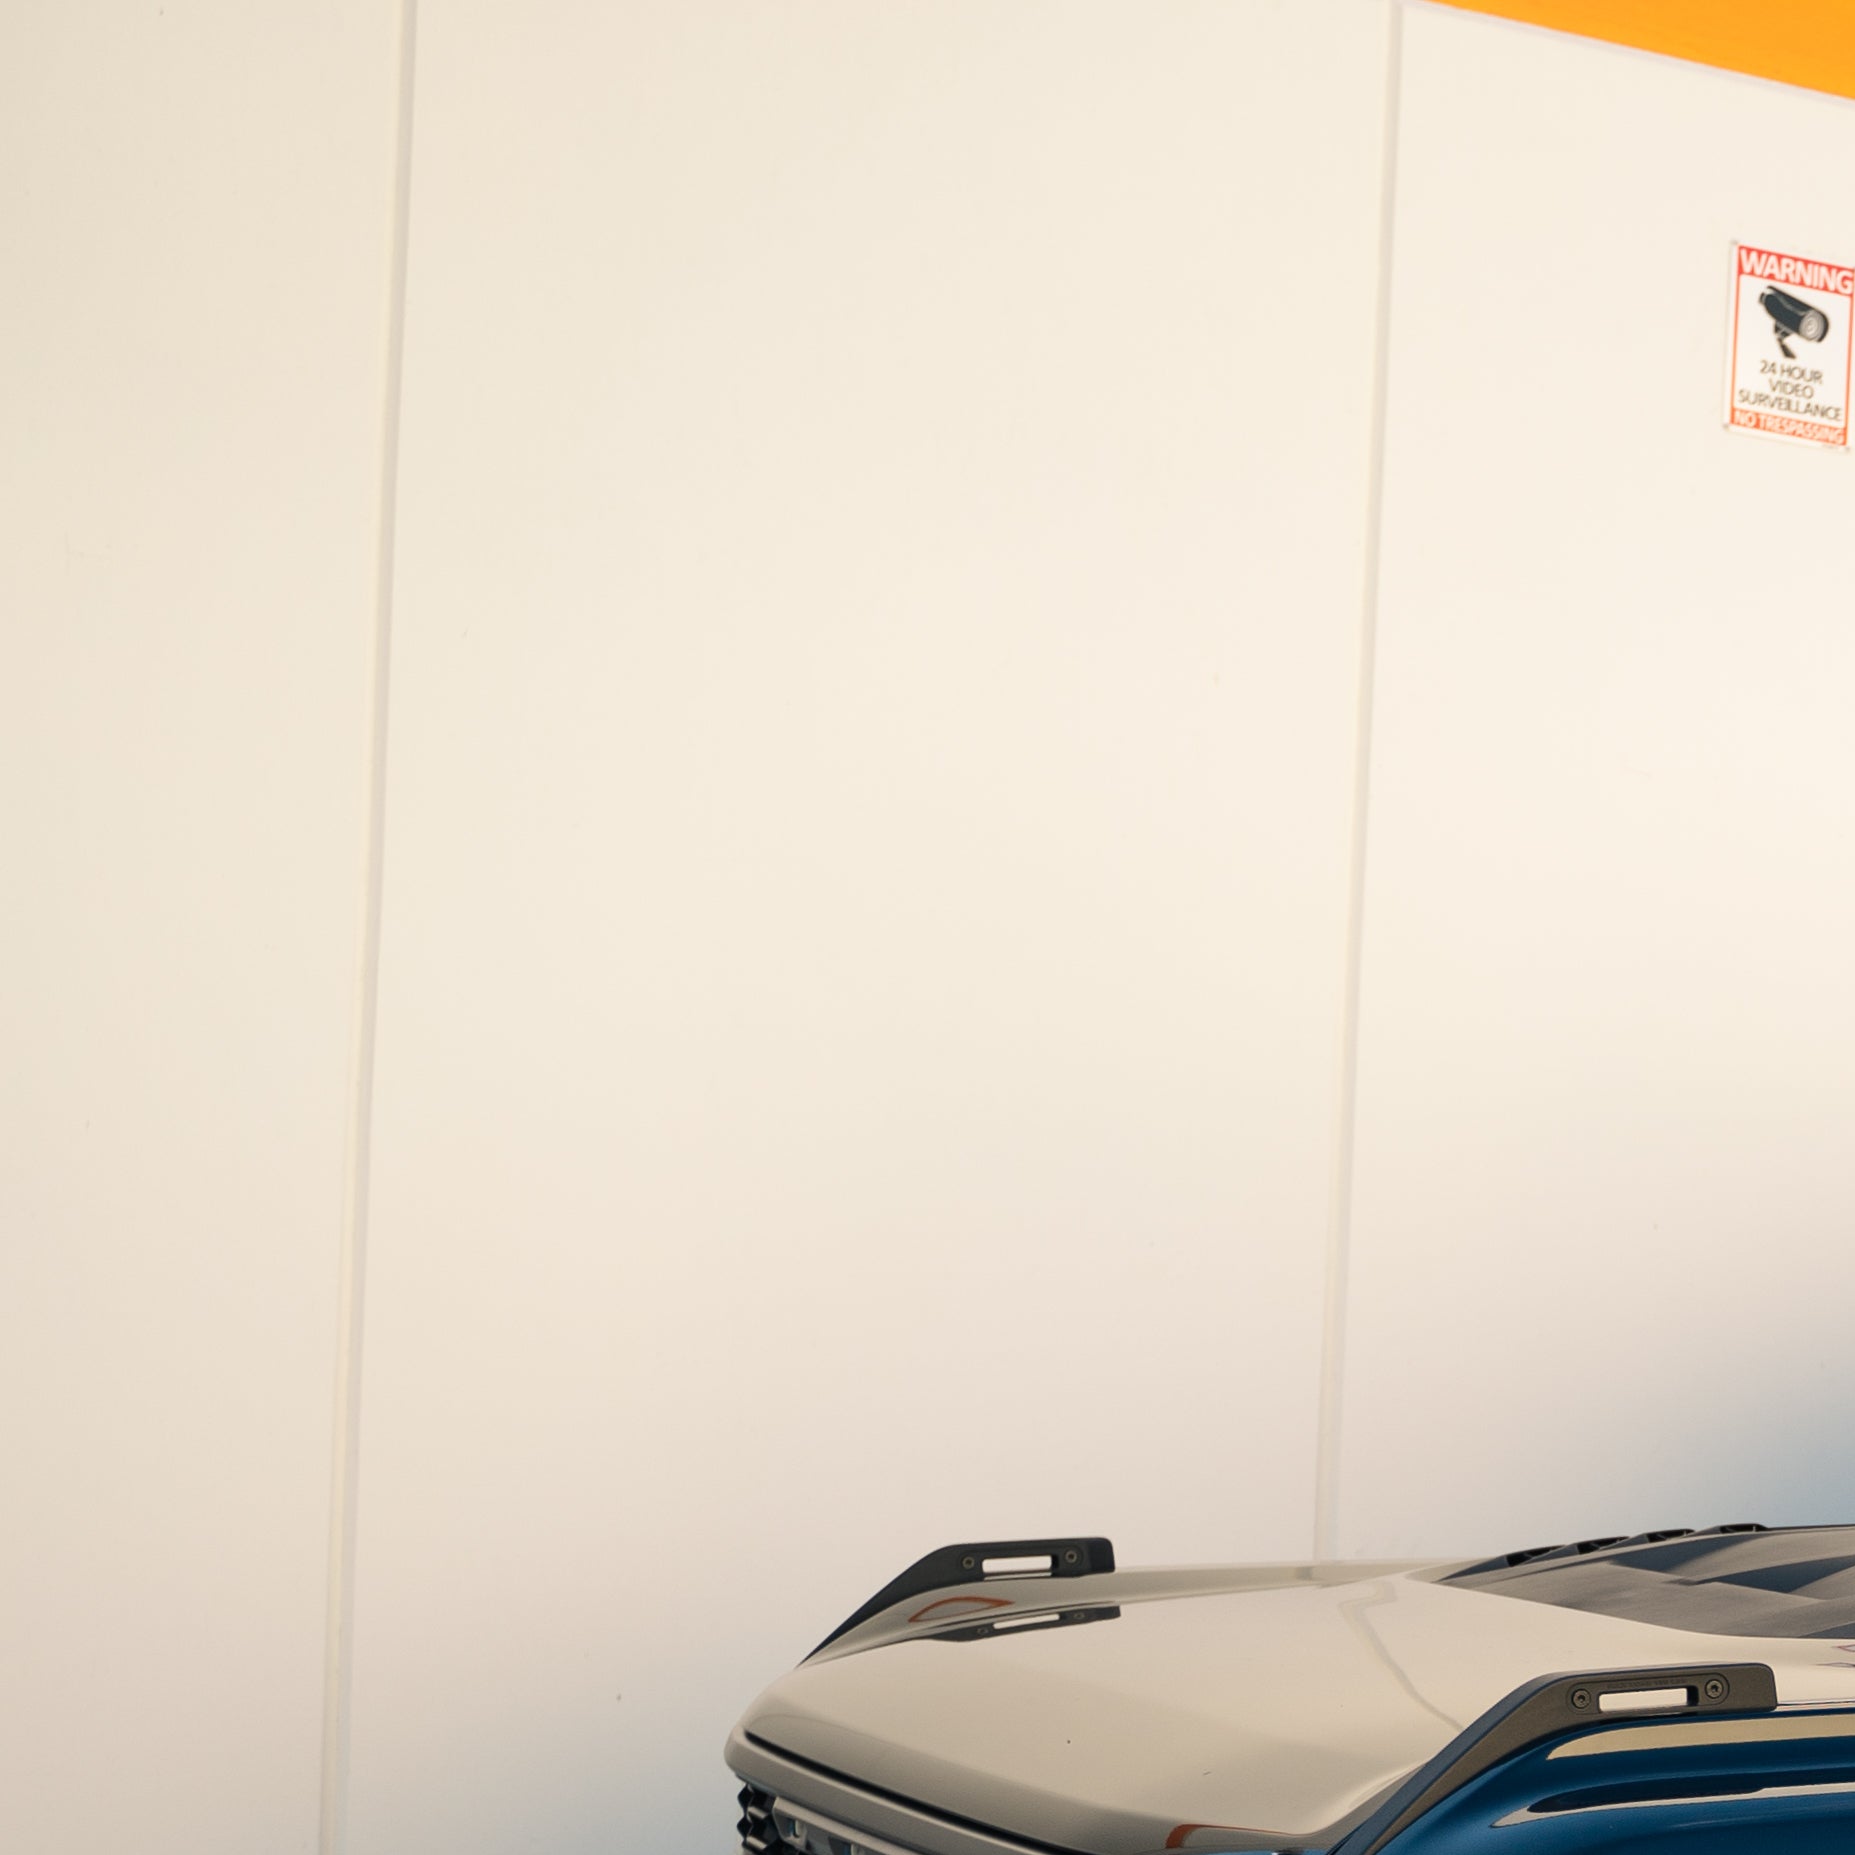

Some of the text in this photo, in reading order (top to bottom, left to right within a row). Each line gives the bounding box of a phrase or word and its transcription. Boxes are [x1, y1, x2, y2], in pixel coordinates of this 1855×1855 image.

[1739, 248, 1854, 295] WARNING
[1759, 359, 1823, 385] 24 HOUR
[1768, 378, 1814, 399] VIDEO
[1738, 388, 1842, 422] SURVEILLANCE
[1734, 410, 1845, 444] NO TRESPASSING
